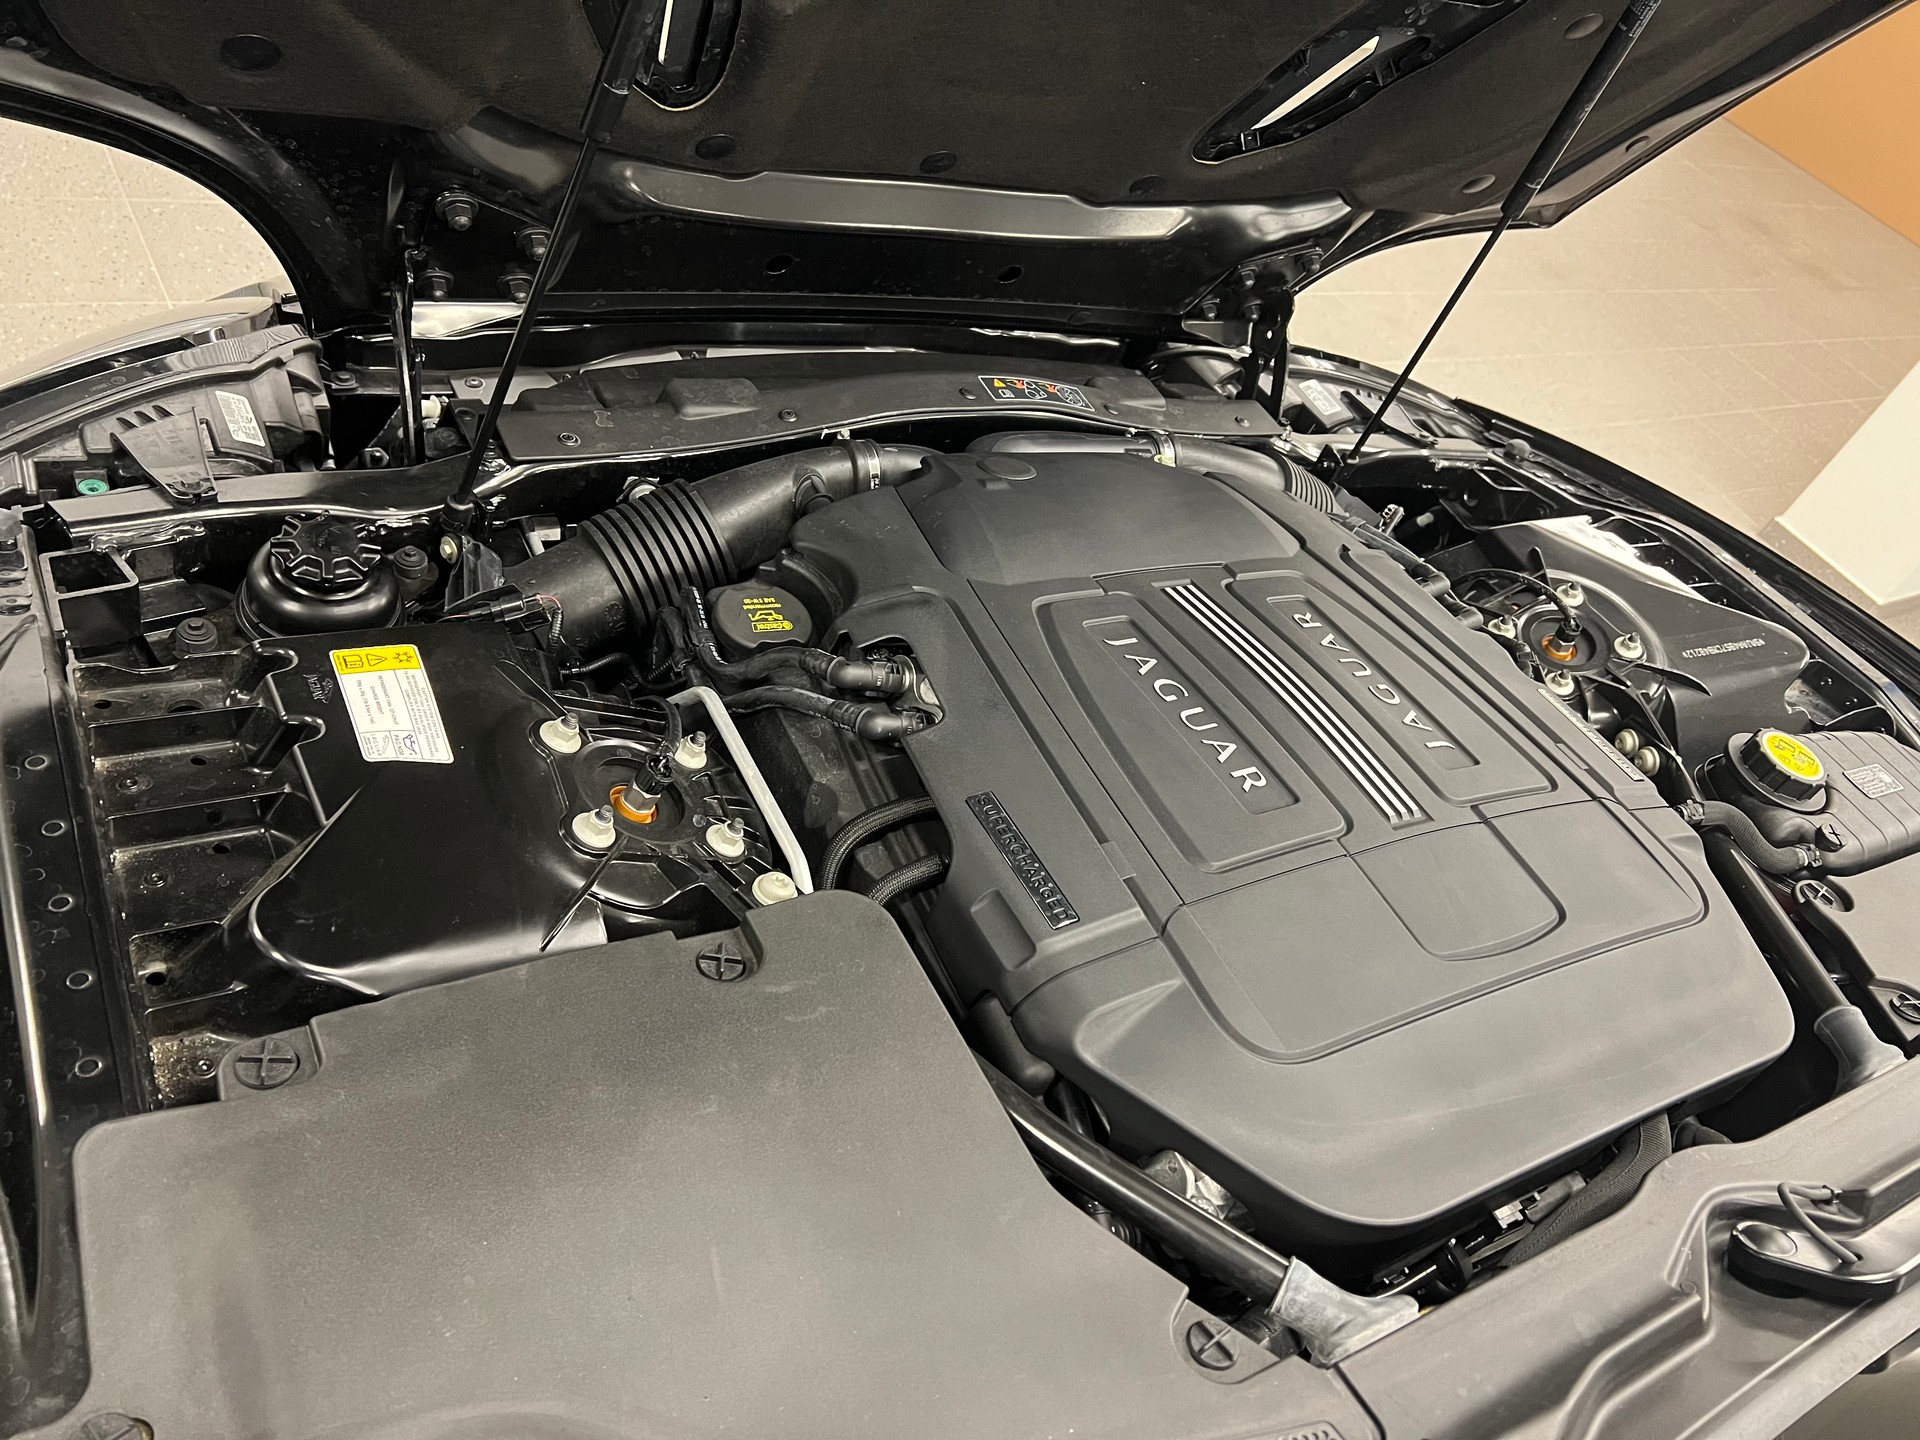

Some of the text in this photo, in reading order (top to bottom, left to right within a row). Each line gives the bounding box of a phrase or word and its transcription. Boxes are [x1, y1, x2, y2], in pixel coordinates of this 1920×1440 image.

[369, 733, 382, 756] JAGUAR
[1103, 637, 1267, 793] JAGUAR
[1292, 611, 1456, 749] JAGUAR
[978, 795, 1069, 920] SUPERCHARGED
